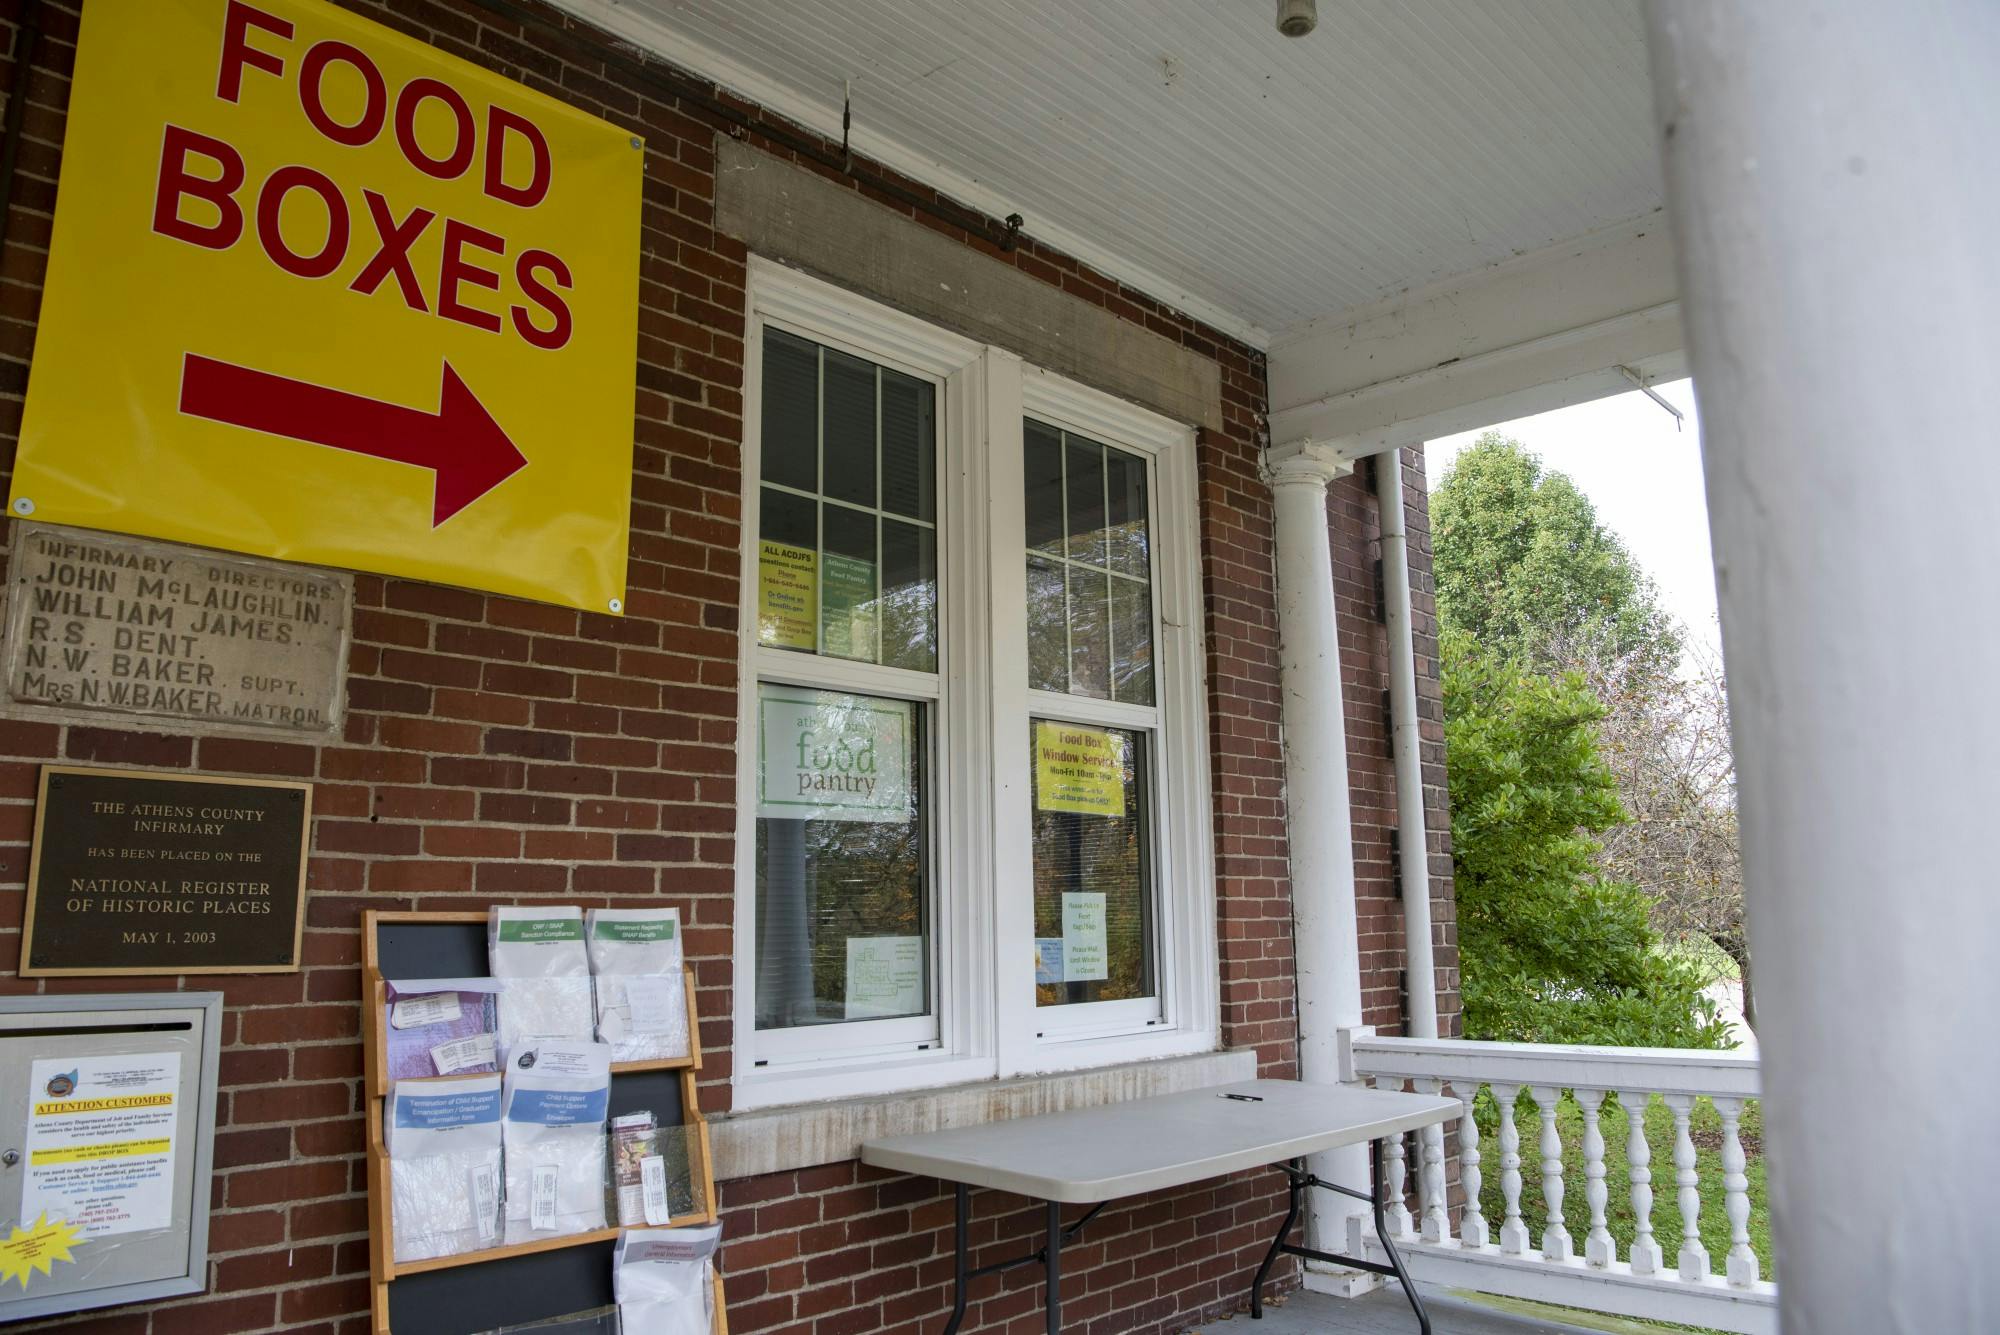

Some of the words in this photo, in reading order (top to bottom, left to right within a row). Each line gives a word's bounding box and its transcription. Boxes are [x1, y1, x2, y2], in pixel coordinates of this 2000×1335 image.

[216, 0, 552, 209] FOOD
[151, 122, 574, 351] BOXES
[39, 540, 173, 574] INFIRMARY
[765, 546, 779, 556] ALL
[782, 551, 811, 562] ACDJFS
[37, 562, 116, 593] JOHN
[35, 587, 173, 628] WILLIAM
[1060, 732, 1082, 745] Food
[1085, 736, 1102, 748] Box
[796, 731, 876, 773] food
[1043, 748, 1079, 763] Window
[1050, 766, 1074, 777] Mon-Fri
[1077, 770, 1094, 778] 10am
[797, 772, 877, 799] pantry
[92, 802, 125, 815] THE
[132, 804, 194, 818] ATHENS
[201, 808, 265, 821] COUNTY
[134, 820, 225, 836] INFIRMARY
[88, 847, 114, 858] HAS
[121, 849, 155, 859] BEEN
[161, 850, 210, 861] PLACED
[215, 852, 233, 862] ON
[238, 852, 262, 863] THE
[71, 879, 172, 893] NATIONAL
[181, 881, 270, 896] REGISTER
[66, 898, 93, 912] OF
[102, 900, 194, 913] HISTORIC
[203, 900, 271, 914] PLACES
[122, 932, 159, 944] MAY
[166, 932, 176, 945] 1,
[184, 932, 216, 944] 2003
[36, 1100, 104, 1113] ATTENTION
[106, 1095, 172, 1107] CUSTOMERS
